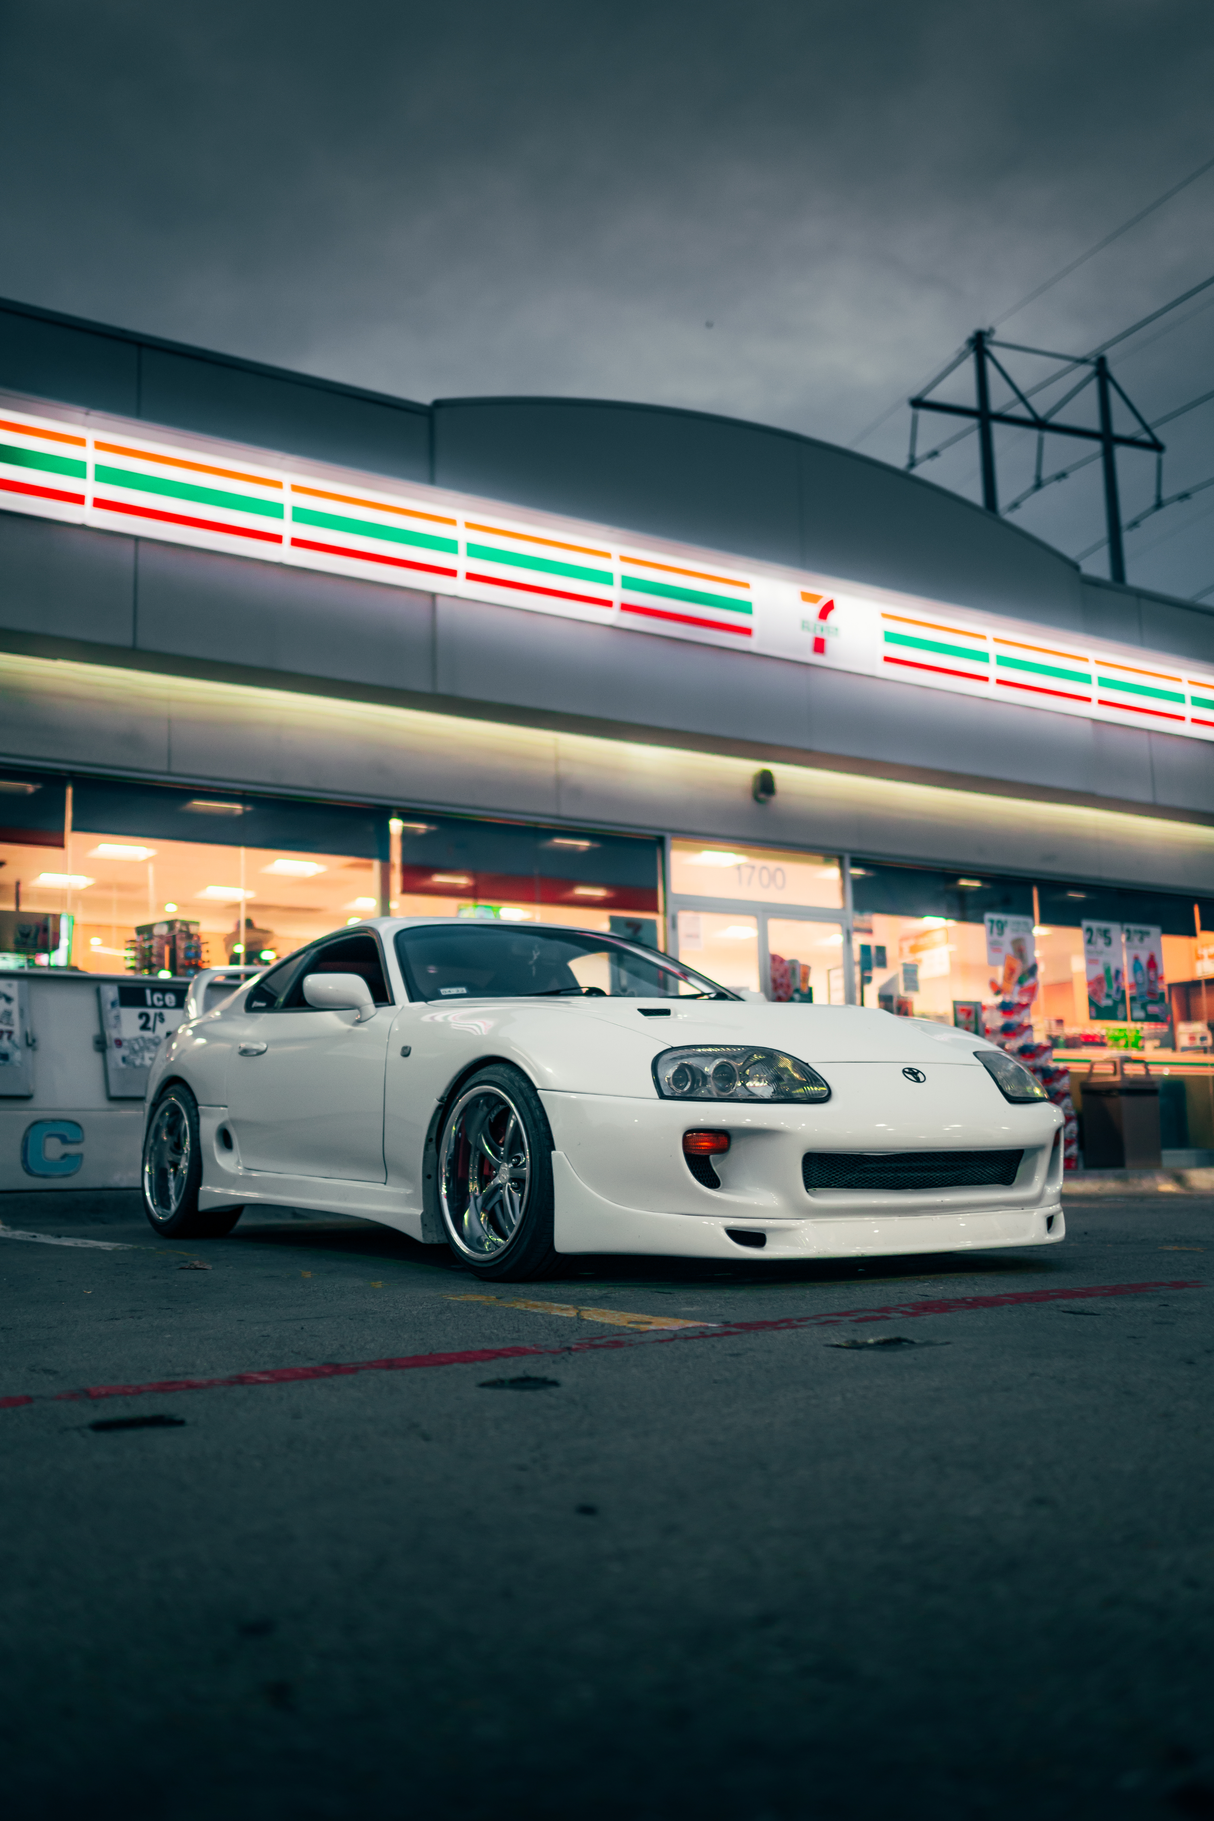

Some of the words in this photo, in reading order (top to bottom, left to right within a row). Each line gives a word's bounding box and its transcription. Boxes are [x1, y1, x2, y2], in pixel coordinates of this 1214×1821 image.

[800, 590, 835, 654] 7
[735, 864, 786, 891] 1700
[145, 987, 176, 1007] Ice
[21, 1118, 84, 1178] C
